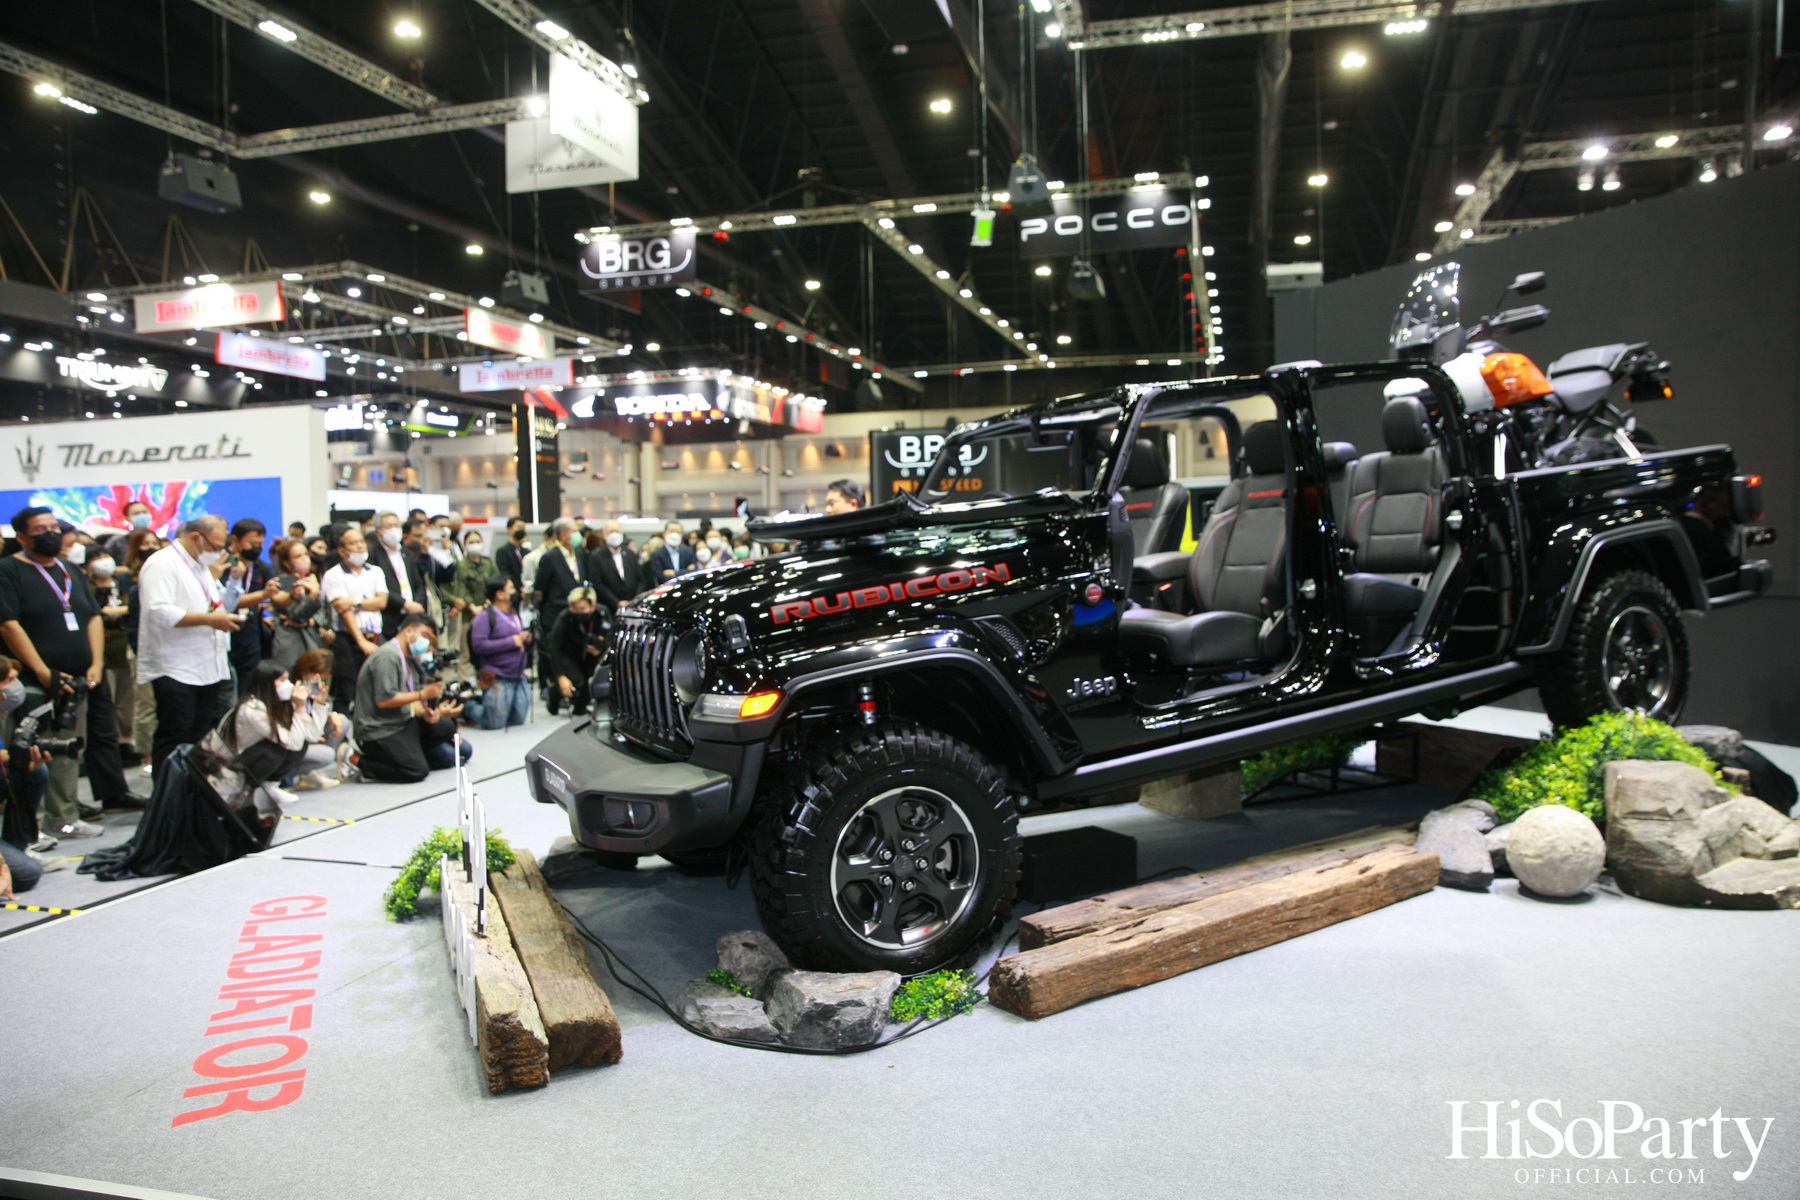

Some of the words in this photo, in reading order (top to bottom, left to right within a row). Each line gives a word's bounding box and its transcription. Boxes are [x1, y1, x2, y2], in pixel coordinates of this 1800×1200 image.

[1020, 204, 1192, 243] POCCO
[598, 237, 671, 274] BRG
[57, 433, 253, 468] Maserati
[900, 465, 973, 478] GRUP
[770, 562, 1011, 625] RUBICON
[1065, 675, 1118, 700] Jeep
[170, 894, 329, 1129] GLADIATOR
